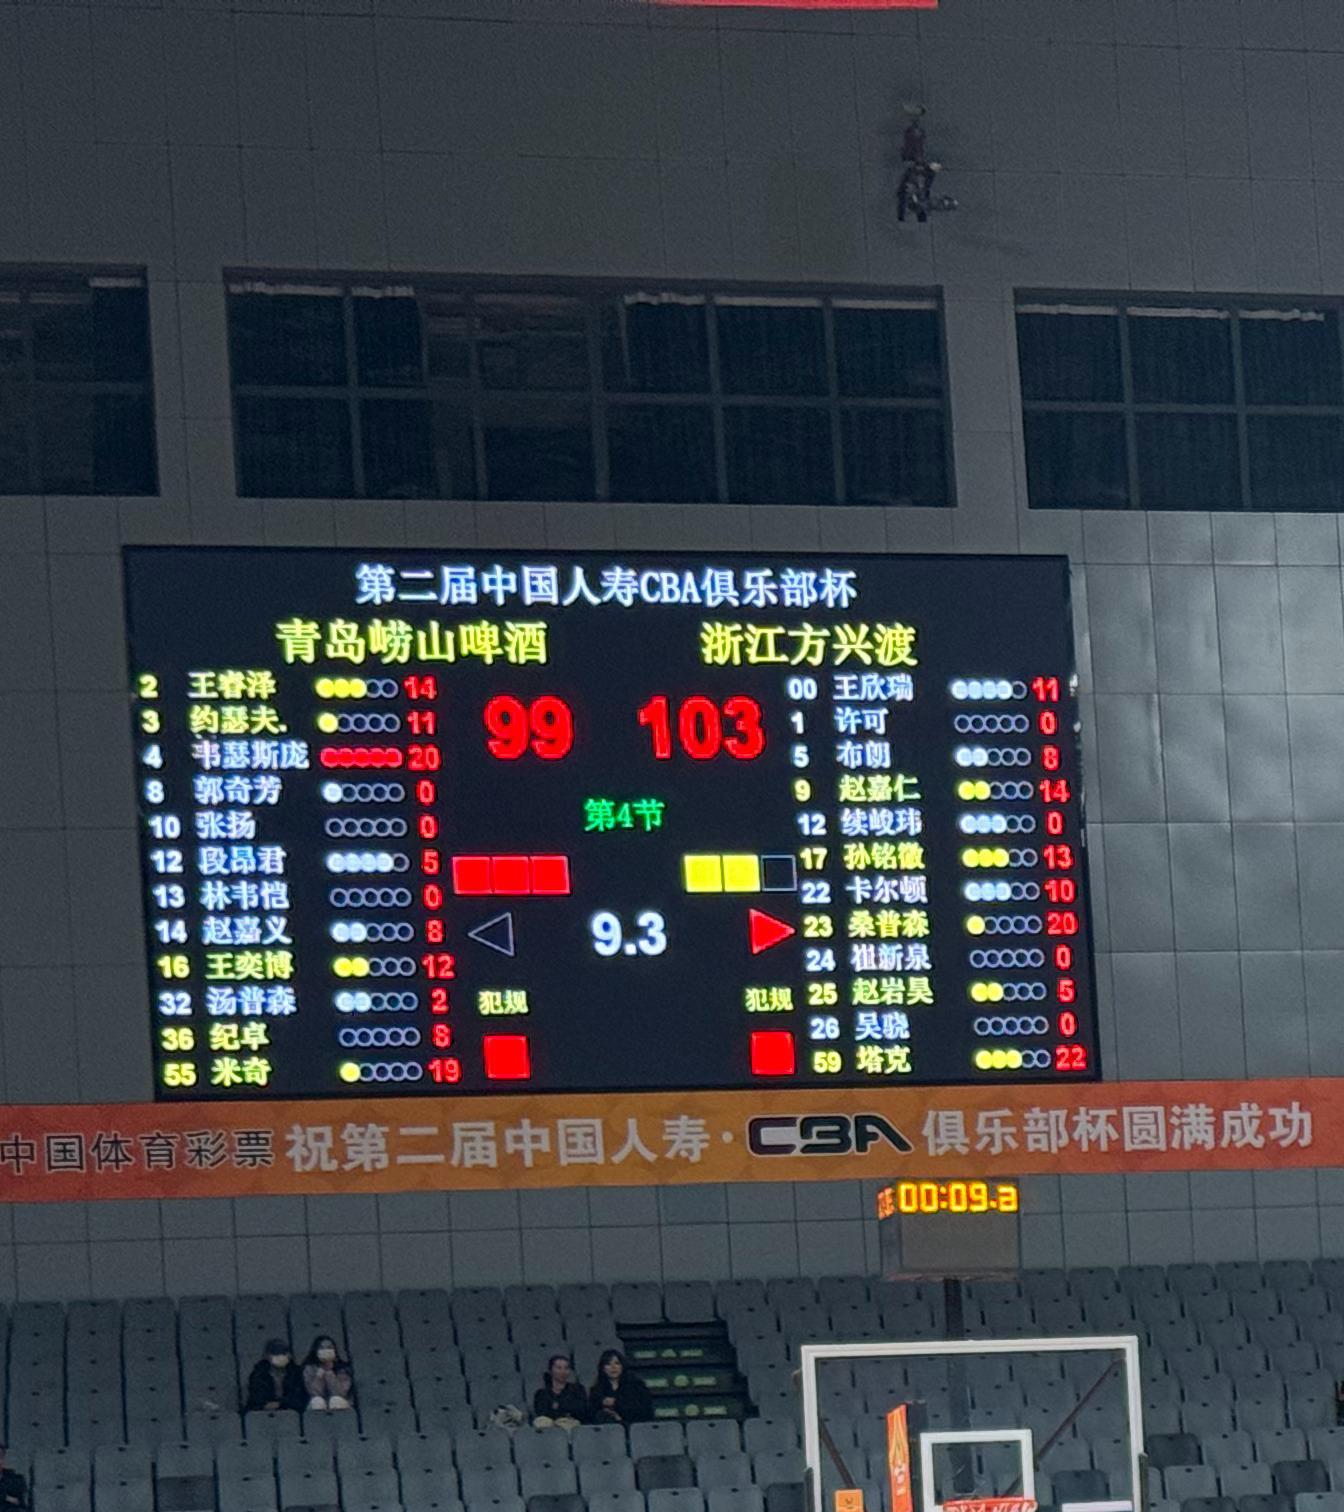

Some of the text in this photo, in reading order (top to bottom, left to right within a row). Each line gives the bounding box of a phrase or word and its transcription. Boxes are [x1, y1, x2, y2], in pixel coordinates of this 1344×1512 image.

[355, 563, 858, 608] 第二届中国人寿CBA俱乐部杯
[276, 619, 547, 664] 青岛崂山啤酒
[700, 622, 918, 667] 浙江方兴渡
[139, 675, 157, 698] 2
[404, 675, 437, 700] 14
[788, 679, 817, 700] 00
[1032, 678, 1059, 702] 11
[142, 711, 160, 733] 3
[407, 711, 437, 735] 11
[484, 694, 766, 761] 99 103
[791, 708, 1057, 735] 1 许可 0
[143, 744, 163, 769] 4
[407, 746, 440, 771] 20
[793, 741, 1060, 769] 5 布朗 8
[145, 781, 164, 802] 8
[417, 781, 435, 803] 0
[795, 780, 811, 801] 9
[1039, 779, 1070, 802] 14
[149, 817, 181, 838] 10
[419, 815, 438, 839] 0
[584, 798, 664, 832] 第4节
[798, 814, 827, 836] 12
[1046, 812, 1063, 835] 0
[151, 851, 184, 874] 12
[422, 850, 440, 875] 5
[800, 848, 828, 869] 17
[1043, 845, 1073, 869] 13
[153, 886, 185, 909] 13
[424, 885, 442, 909] 0
[802, 882, 831, 904] 22
[1044, 879, 1075, 903] 10
[155, 921, 187, 943] 14
[426, 920, 444, 943] 8
[591, 911, 668, 957] 9.3
[804, 916, 833, 938] 23
[1047, 913, 1078, 936] 20
[157, 955, 190, 978] 16
[421, 955, 455, 979] 12
[806, 950, 835, 971] 24
[1055, 947, 1072, 970] 0
[159, 992, 192, 1015] 32
[431, 989, 448, 1012] 2
[478, 990, 529, 1016] 犯规
[745, 987, 793, 1012] 犯规
[808, 983, 838, 1006] 25
[1057, 980, 1075, 1003] 5
[161, 1028, 194, 1051] 36
[434, 1023, 451, 1047] 8
[810, 1018, 840, 1040] 26
[1059, 1012, 1076, 1037] 0
[164, 1058, 461, 1086] 55 米奇 19
[813, 1051, 842, 1073] 59
[1055, 1048, 1087, 1071] 22
[0, 1128, 274, 1175] 中国体育彩票
